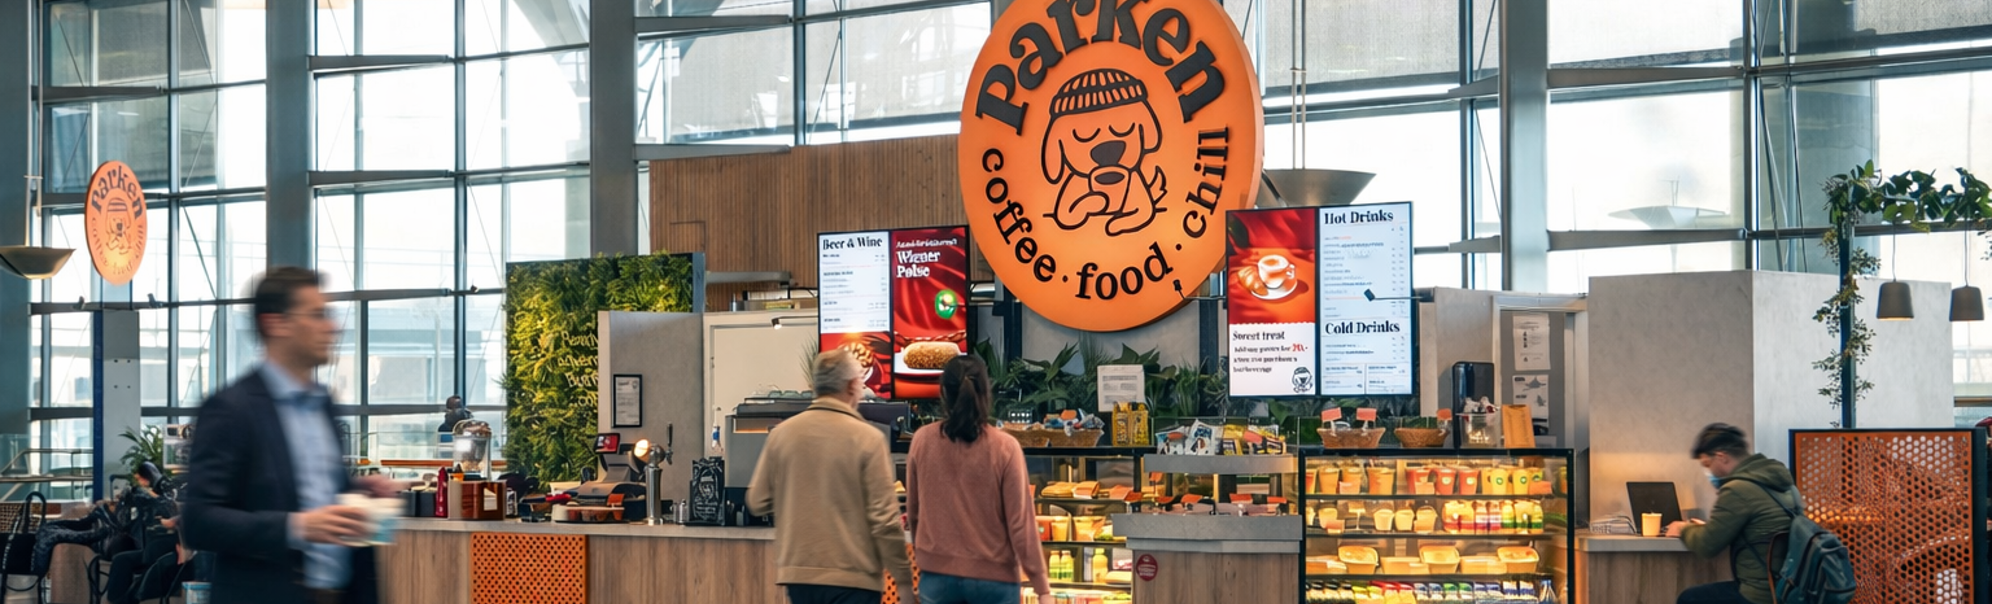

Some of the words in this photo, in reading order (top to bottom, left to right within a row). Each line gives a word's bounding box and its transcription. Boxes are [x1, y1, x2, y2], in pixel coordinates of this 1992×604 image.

[975, 0, 1225, 136] Parken
[982, 148, 1057, 282] coffee
[1075, 241, 1174, 300] food
[1183, 127, 1229, 238] chill
[1324, 212, 1347, 225] Hot
[1350, 209, 1394, 224] Drinks
[822, 239, 845, 250] Beer
[847, 237, 855, 248] &
[857, 236, 883, 247] Wine
[1325, 321, 1353, 335] Cold
[1355, 320, 1400, 334] Drinks
